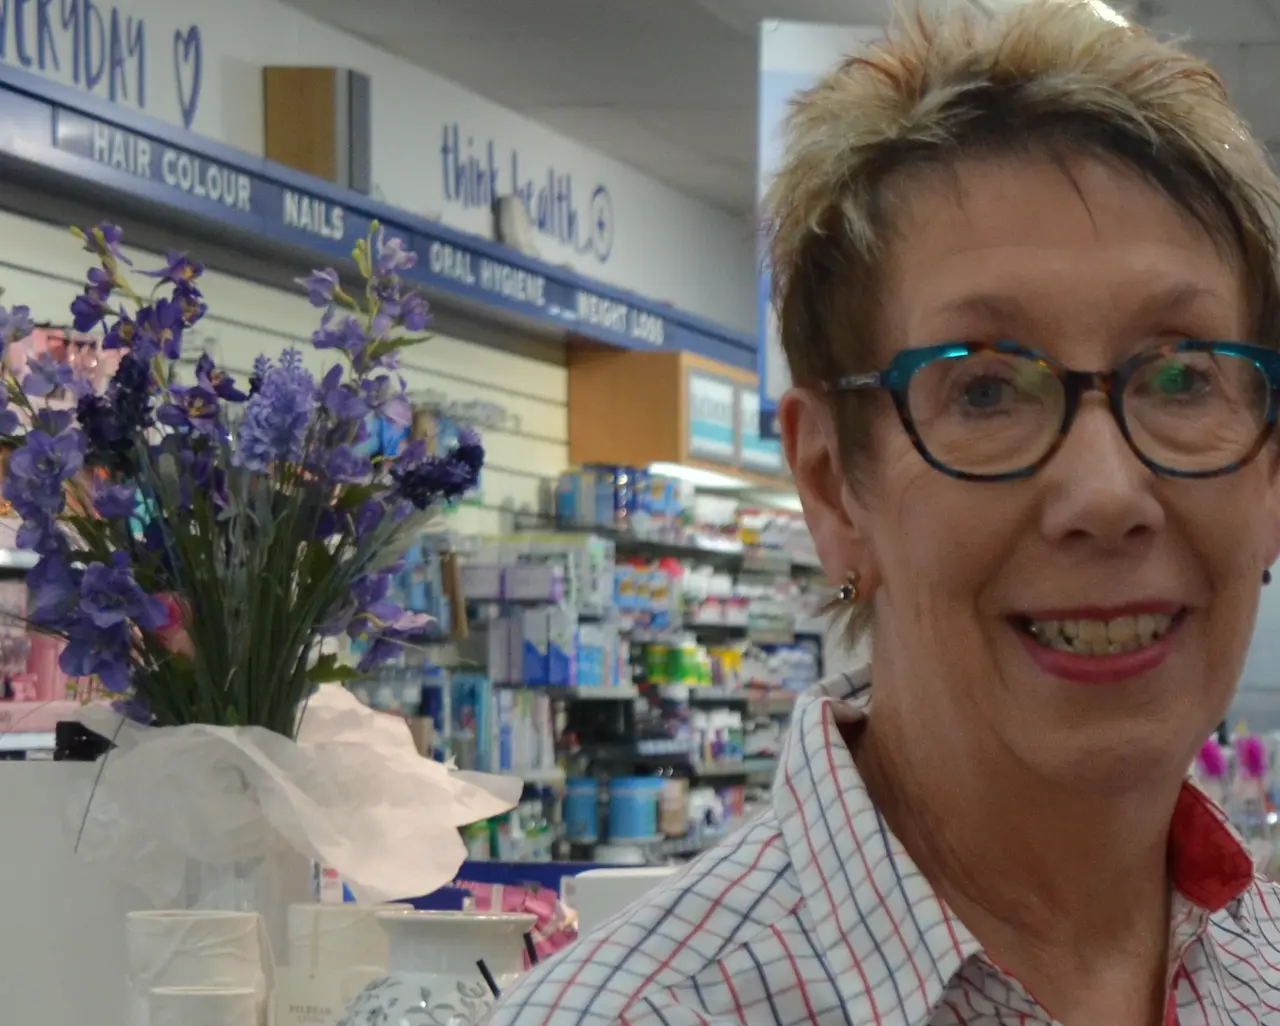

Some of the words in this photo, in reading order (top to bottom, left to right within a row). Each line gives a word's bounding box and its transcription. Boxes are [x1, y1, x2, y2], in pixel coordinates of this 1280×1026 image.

[93, 124, 151, 178] HAIR
[161, 149, 251, 212] COLOUR
[284, 188, 345, 241] NAILS
[429, 240, 476, 285] ORAL
[479, 259, 547, 307] HYGIENE
